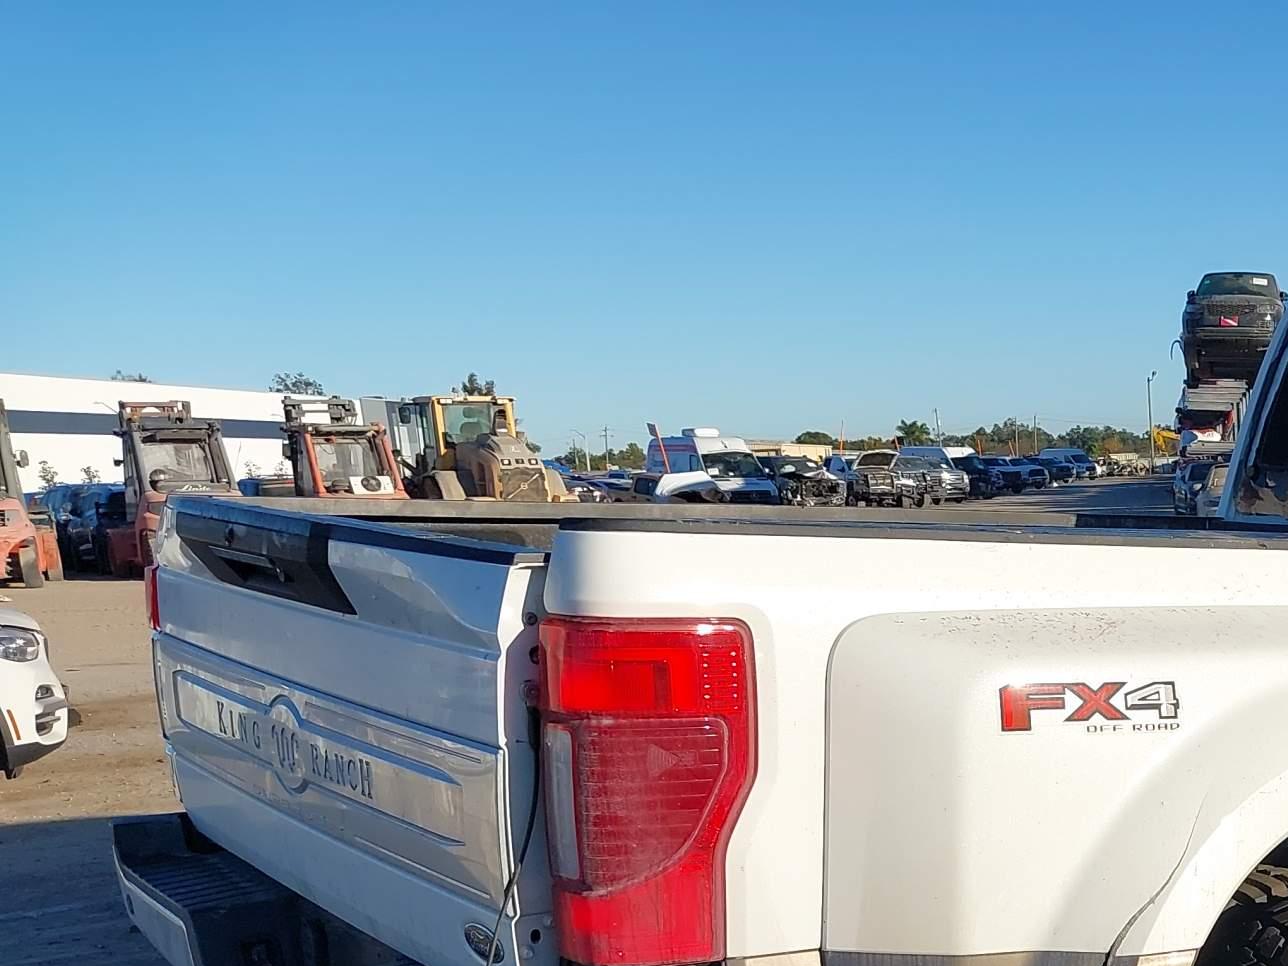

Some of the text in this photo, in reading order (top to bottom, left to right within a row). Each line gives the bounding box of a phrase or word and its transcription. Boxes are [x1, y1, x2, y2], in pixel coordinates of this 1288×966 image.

[999, 681, 1179, 732] FX4
[1086, 721, 1180, 734] OFF ROAD
[216, 700, 374, 800] KING RANCH
